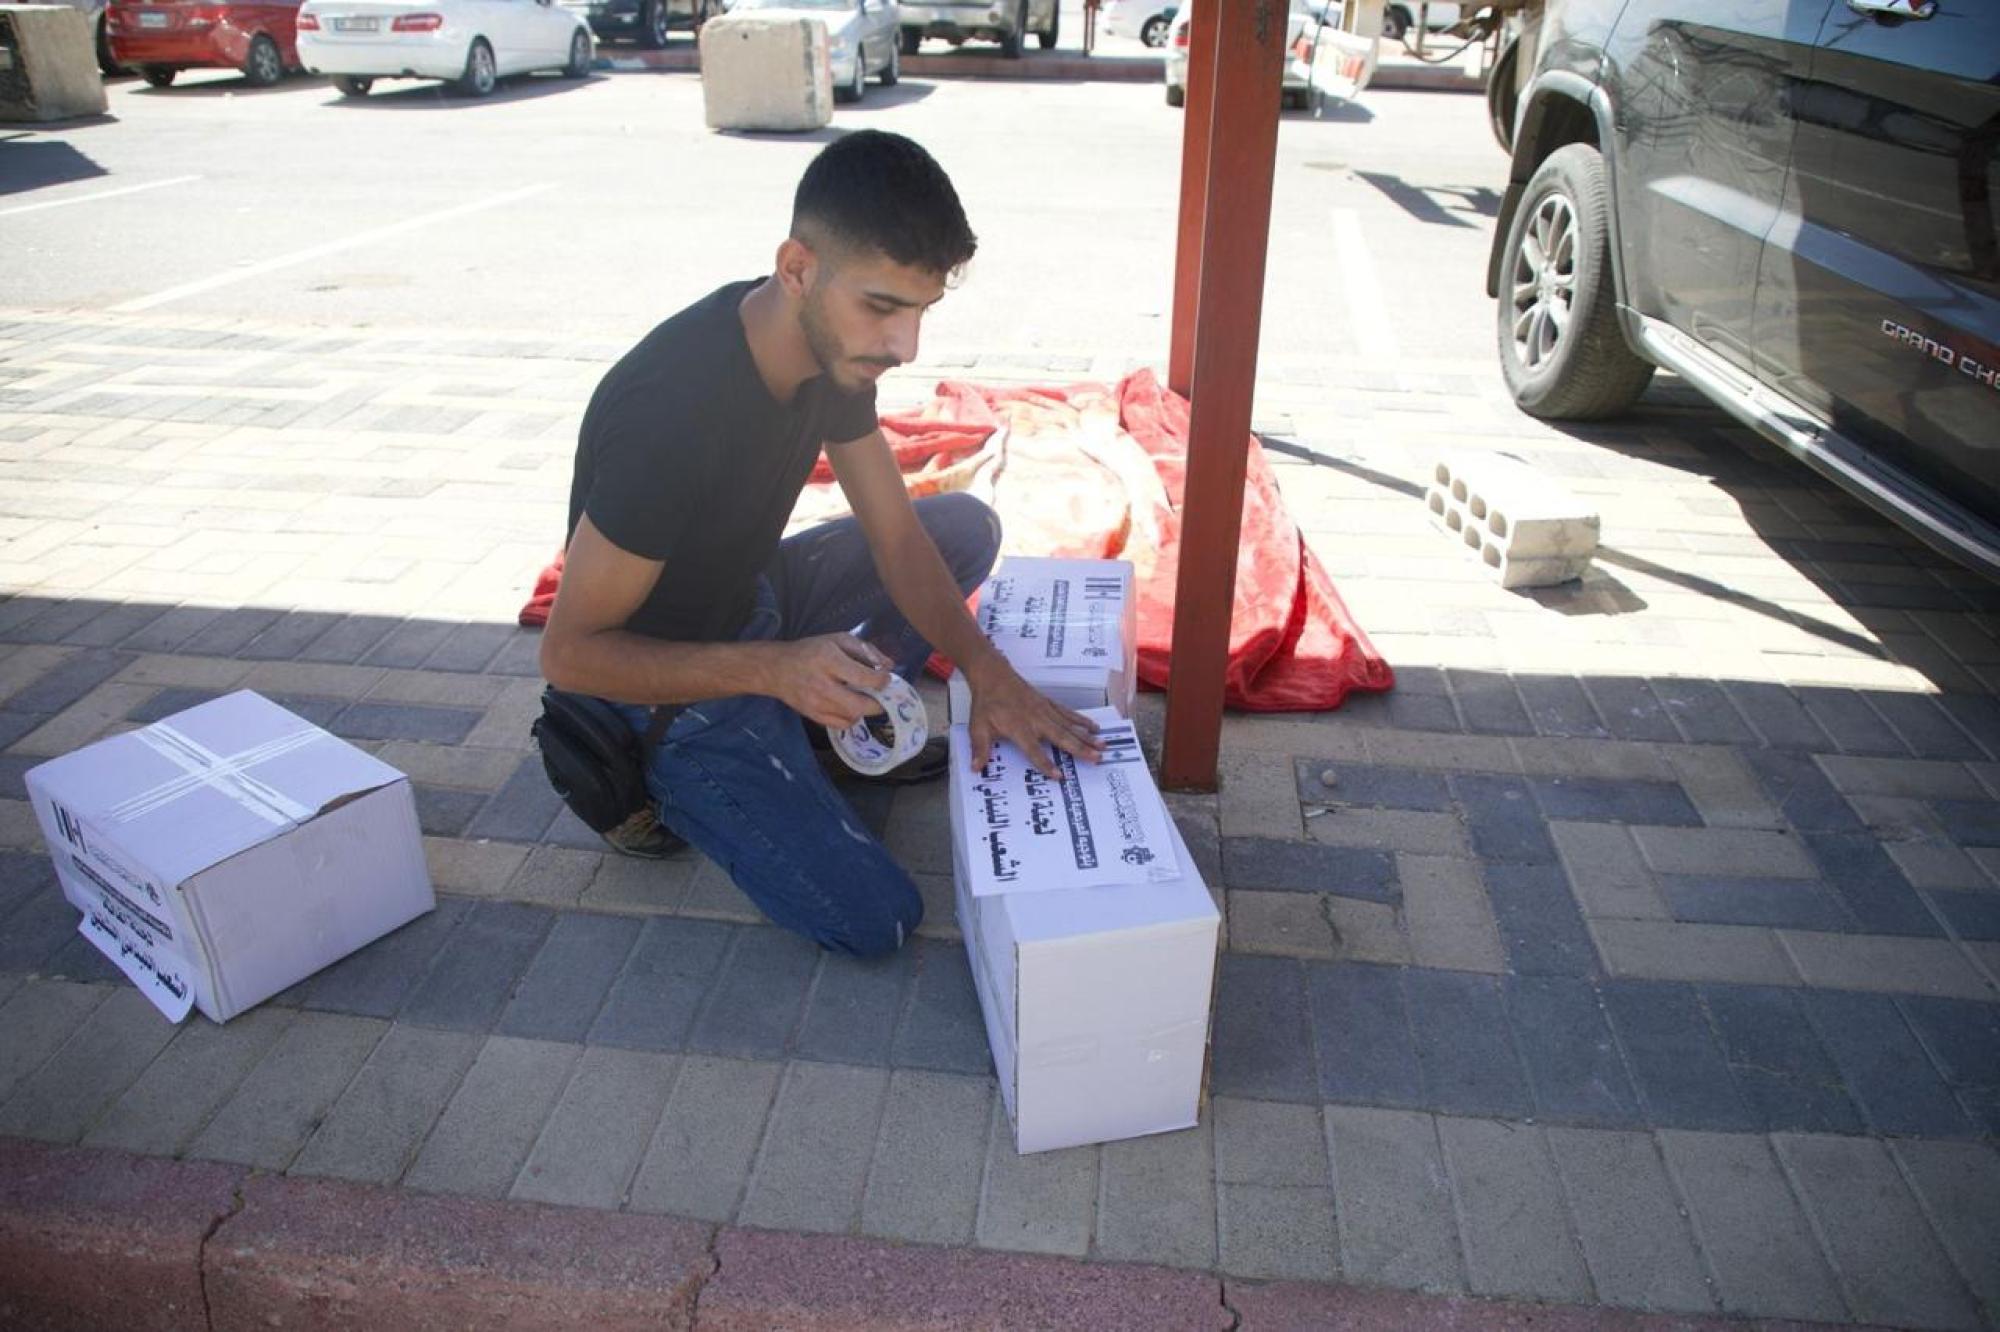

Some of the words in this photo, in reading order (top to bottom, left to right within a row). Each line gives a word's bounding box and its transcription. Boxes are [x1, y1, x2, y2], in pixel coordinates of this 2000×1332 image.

[1882, 319, 1954, 365] GRAND
[972, 783, 1010, 829] اللبناني
[1025, 801, 1056, 835] لجنة
[982, 831, 1021, 881] الشعب
